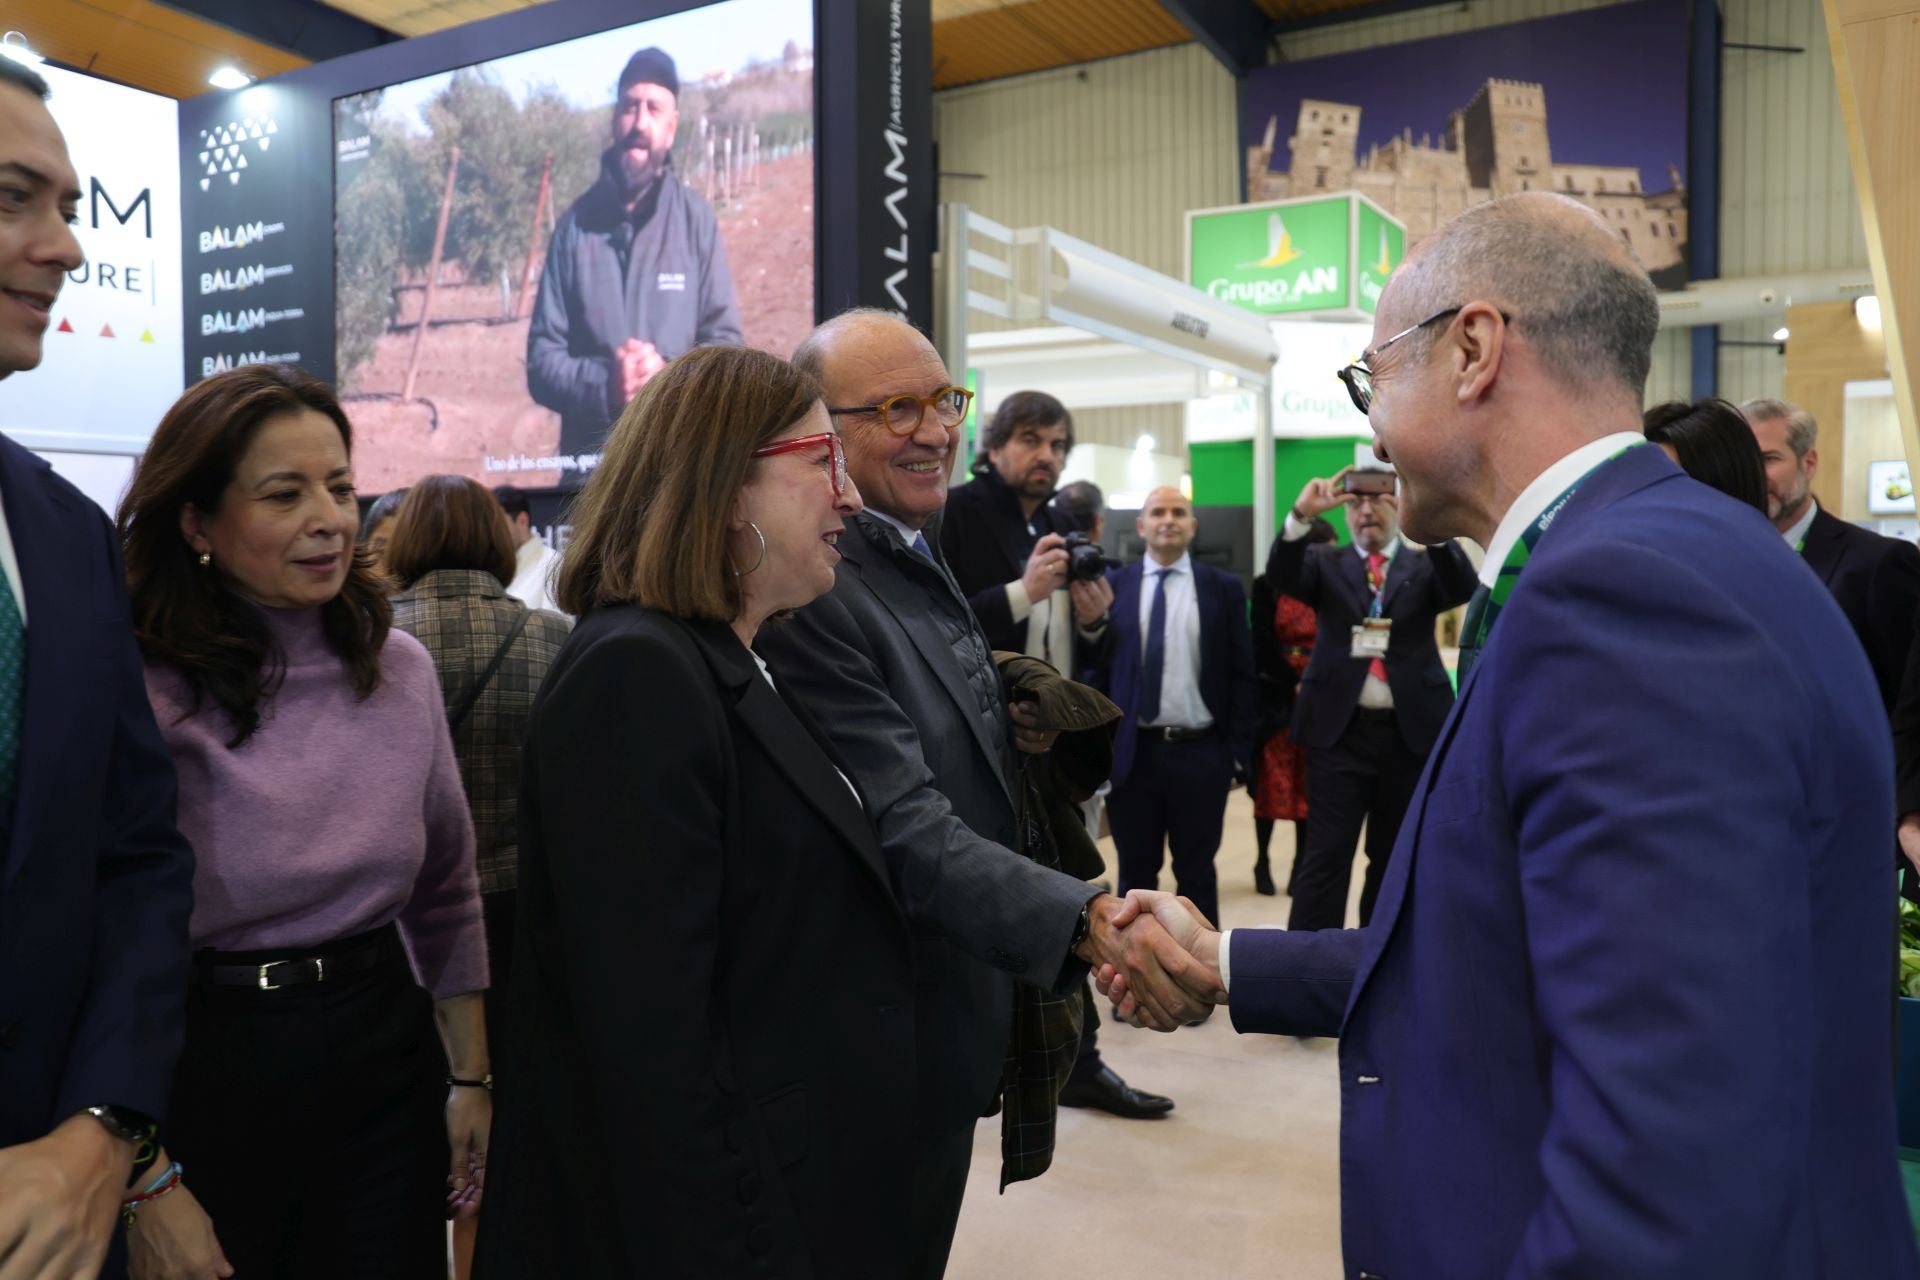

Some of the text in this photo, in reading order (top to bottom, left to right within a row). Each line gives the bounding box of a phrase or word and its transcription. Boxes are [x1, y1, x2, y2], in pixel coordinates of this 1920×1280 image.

[889, 0, 901, 125] AGRICULTUR
[199, 220, 264, 254] BALAM
[200, 263, 265, 295] BALAM
[1207, 266, 1338, 307] Grupo AN
[202, 307, 266, 336] BALAM
[485, 456, 506, 471] Uno
[507, 454, 519, 470] de
[520, 454, 537, 470] los
